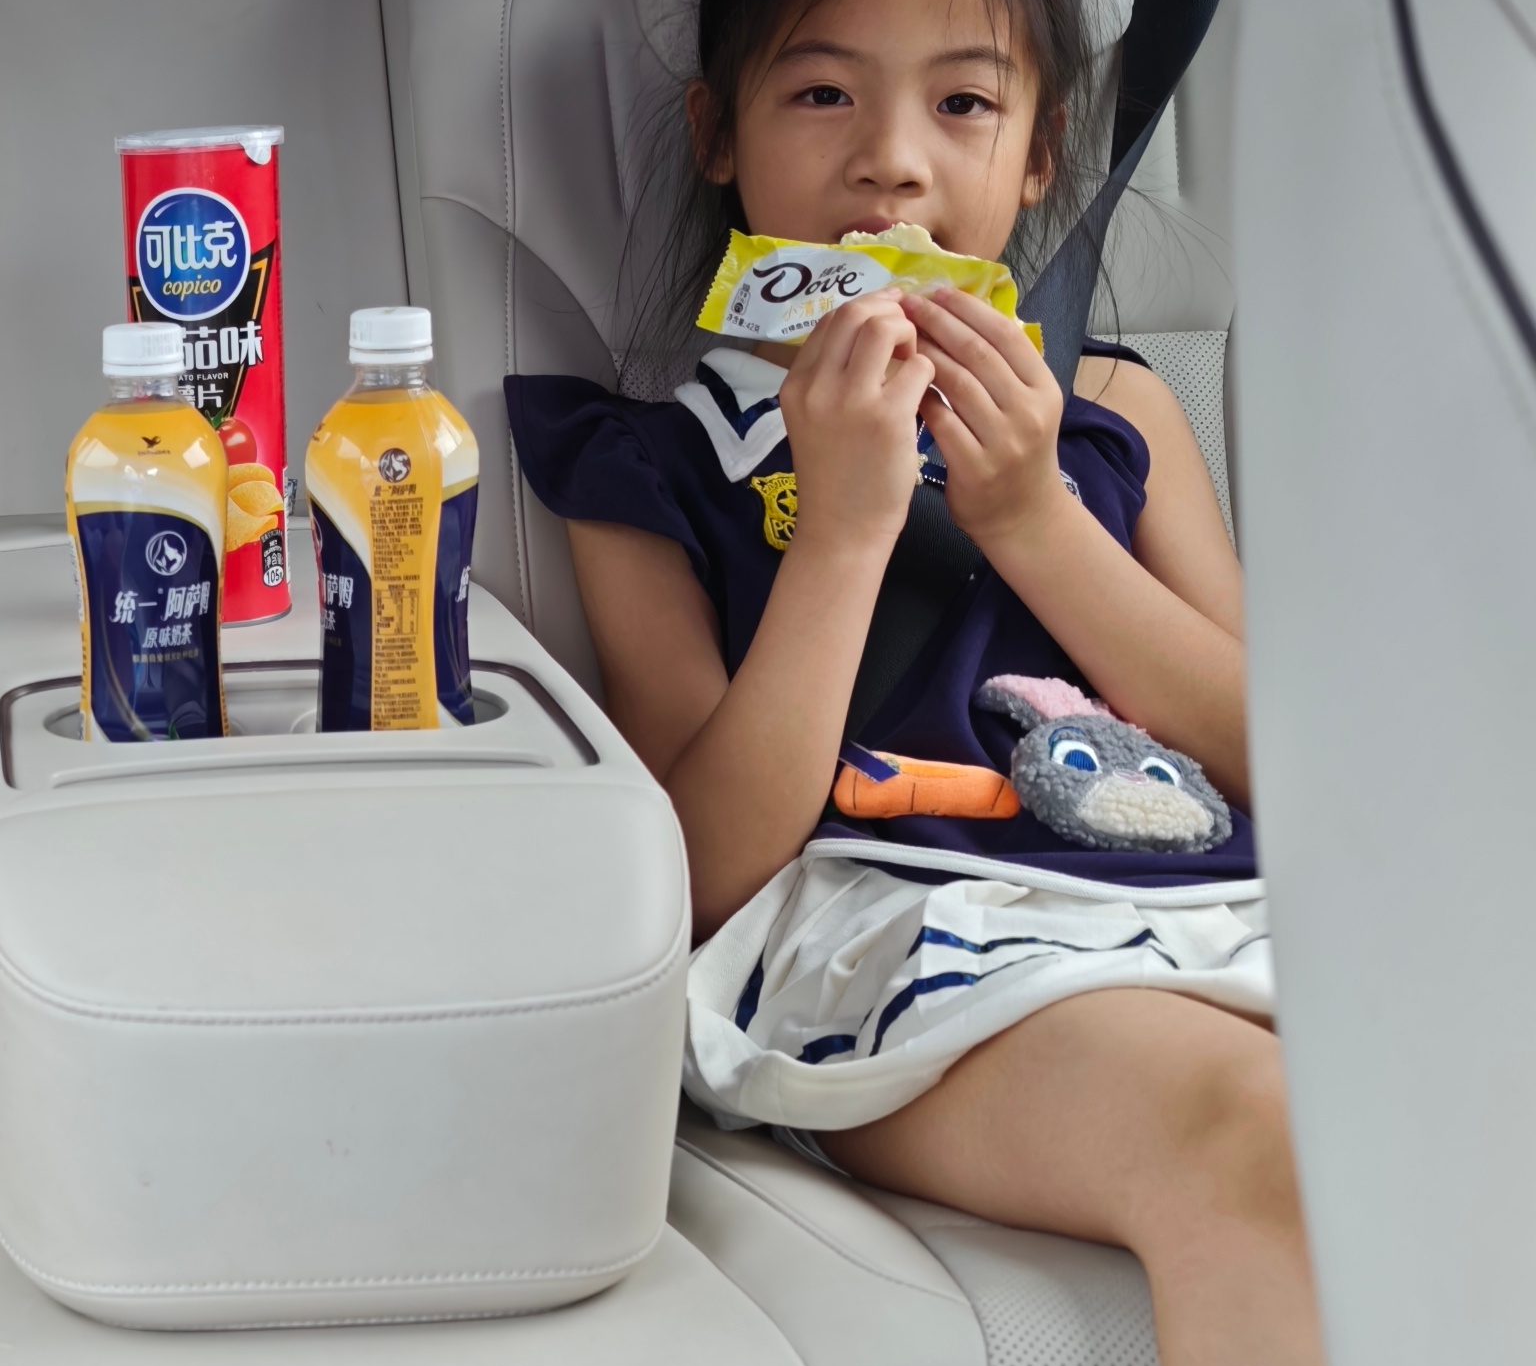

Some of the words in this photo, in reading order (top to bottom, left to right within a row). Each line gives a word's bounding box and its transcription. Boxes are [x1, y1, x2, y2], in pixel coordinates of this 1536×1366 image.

[143, 221, 238, 279] 可比克
[162, 274, 222, 302] copico
[753, 262, 863, 304] Dove
[196, 372, 229, 382] FLAVOR
[142, 622, 193, 649] 原味奶茶
